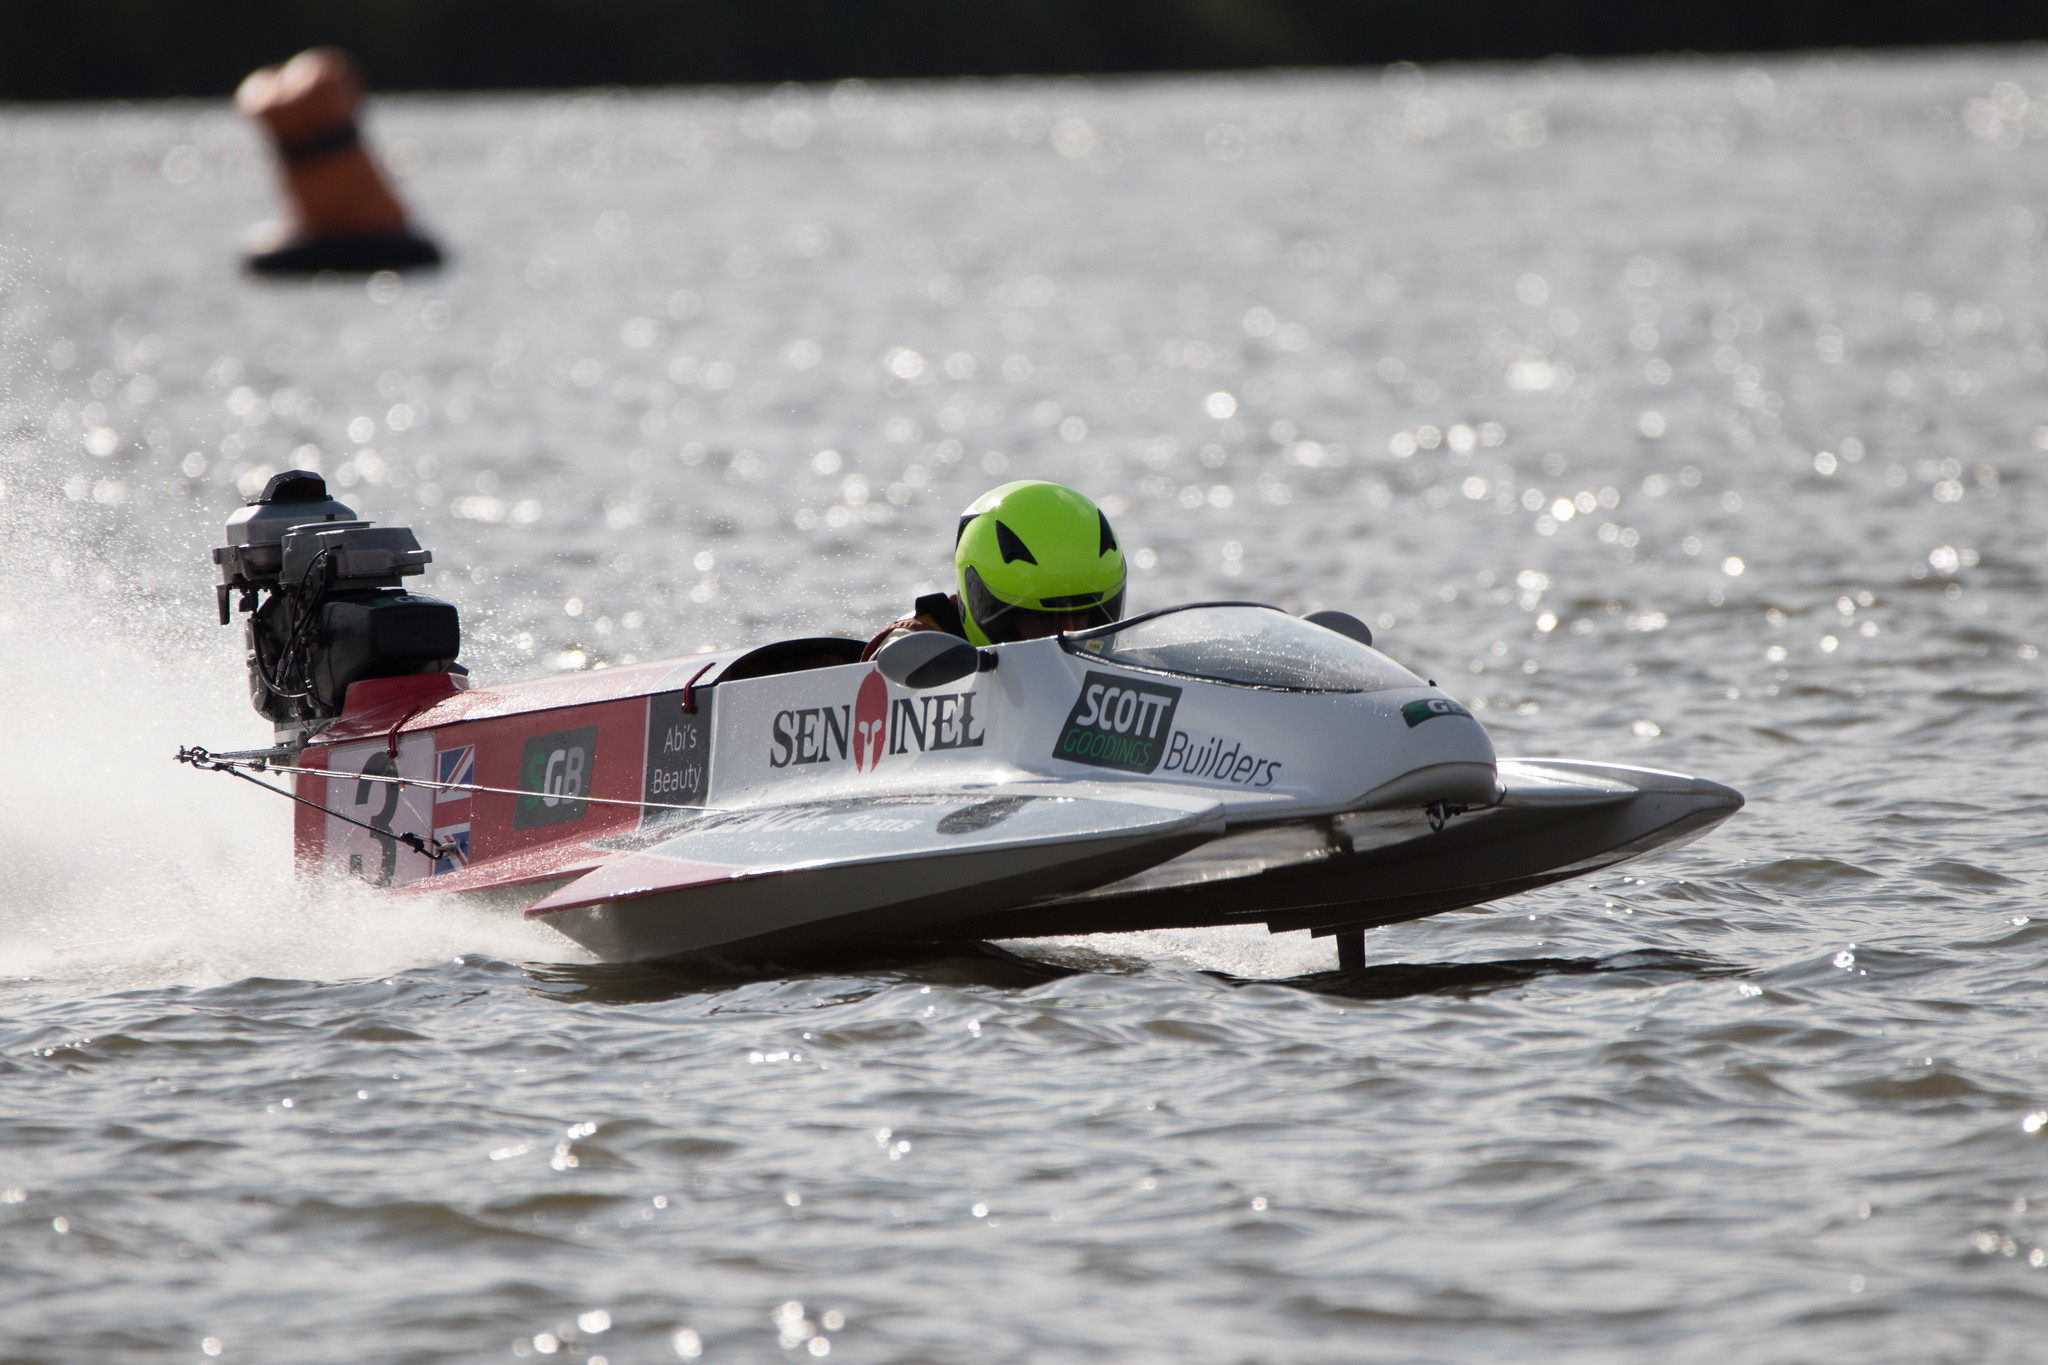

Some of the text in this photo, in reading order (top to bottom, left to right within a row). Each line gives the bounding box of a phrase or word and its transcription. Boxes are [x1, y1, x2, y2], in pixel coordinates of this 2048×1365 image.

[664, 724, 697, 753] Abi's
[1075, 684, 1172, 739] SCOTT
[1063, 729, 1153, 766] GOODINGS
[1163, 731, 1282, 787] Builders
[524, 746, 585, 811] SGB
[653, 764, 702, 793] Beauty
[350, 752, 399, 888] 3
